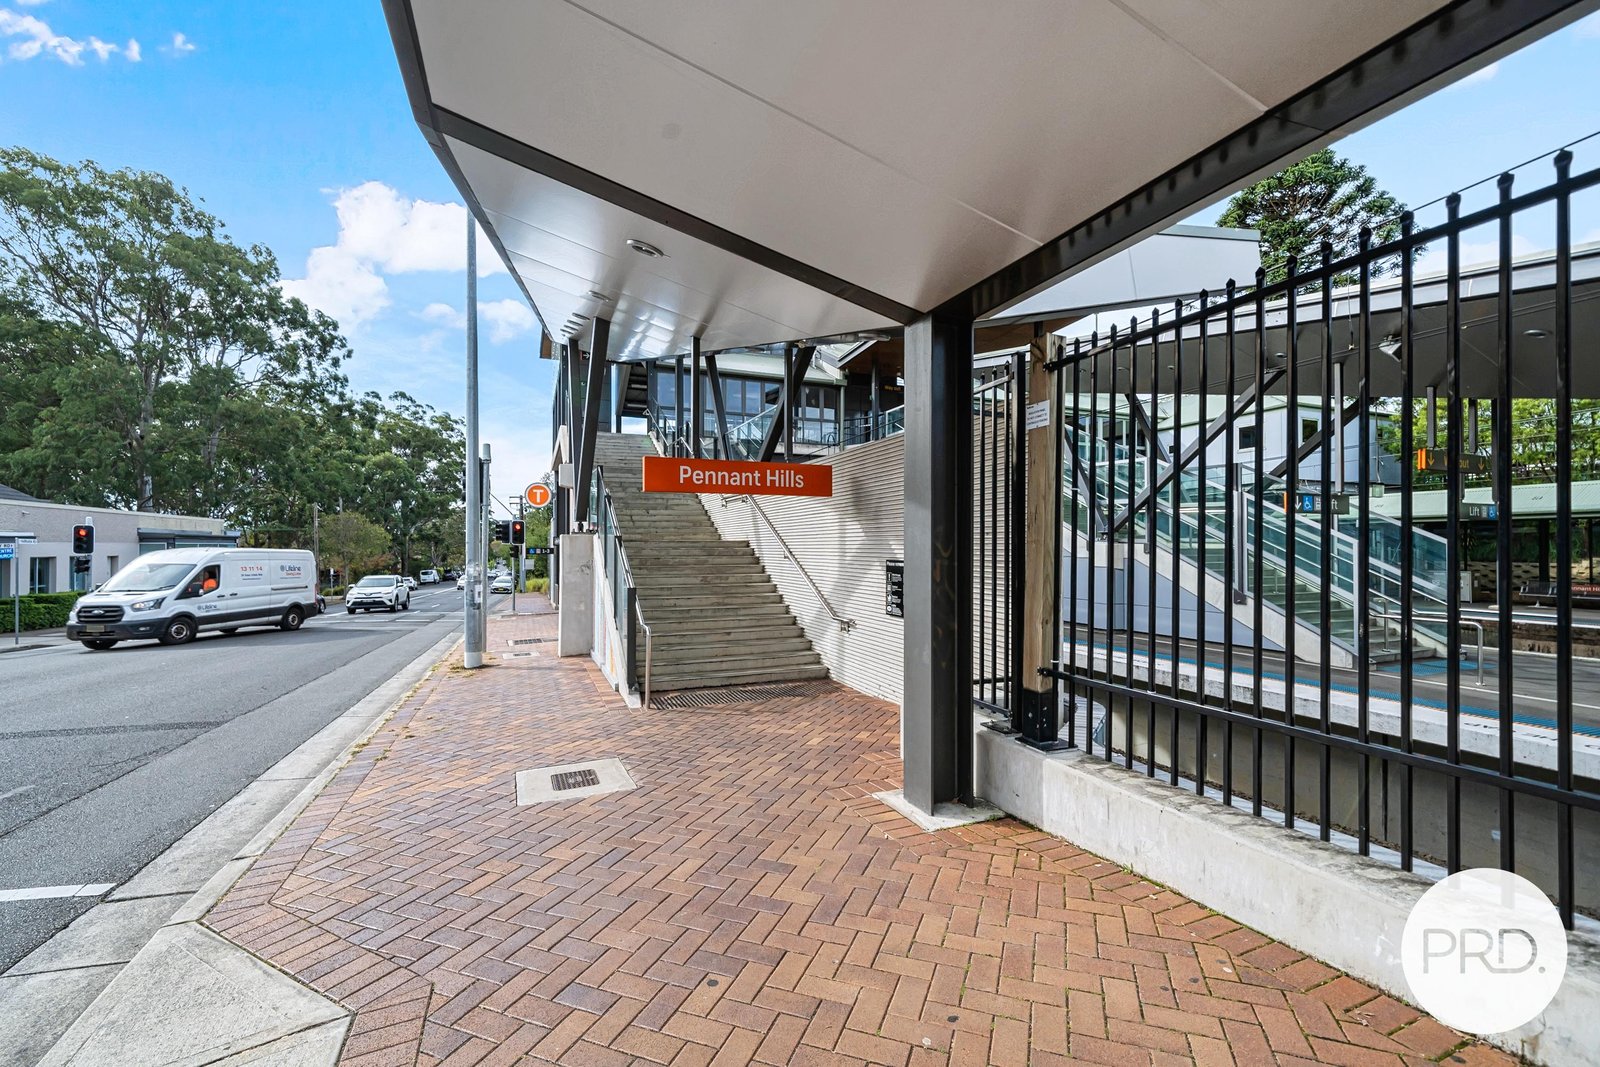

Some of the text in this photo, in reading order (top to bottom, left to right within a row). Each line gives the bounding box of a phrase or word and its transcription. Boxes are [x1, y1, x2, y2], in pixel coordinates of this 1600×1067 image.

[679, 465, 804, 488] Pennant Hills
[532, 489, 544, 503] T
[1469, 506, 1480, 517] Lift
